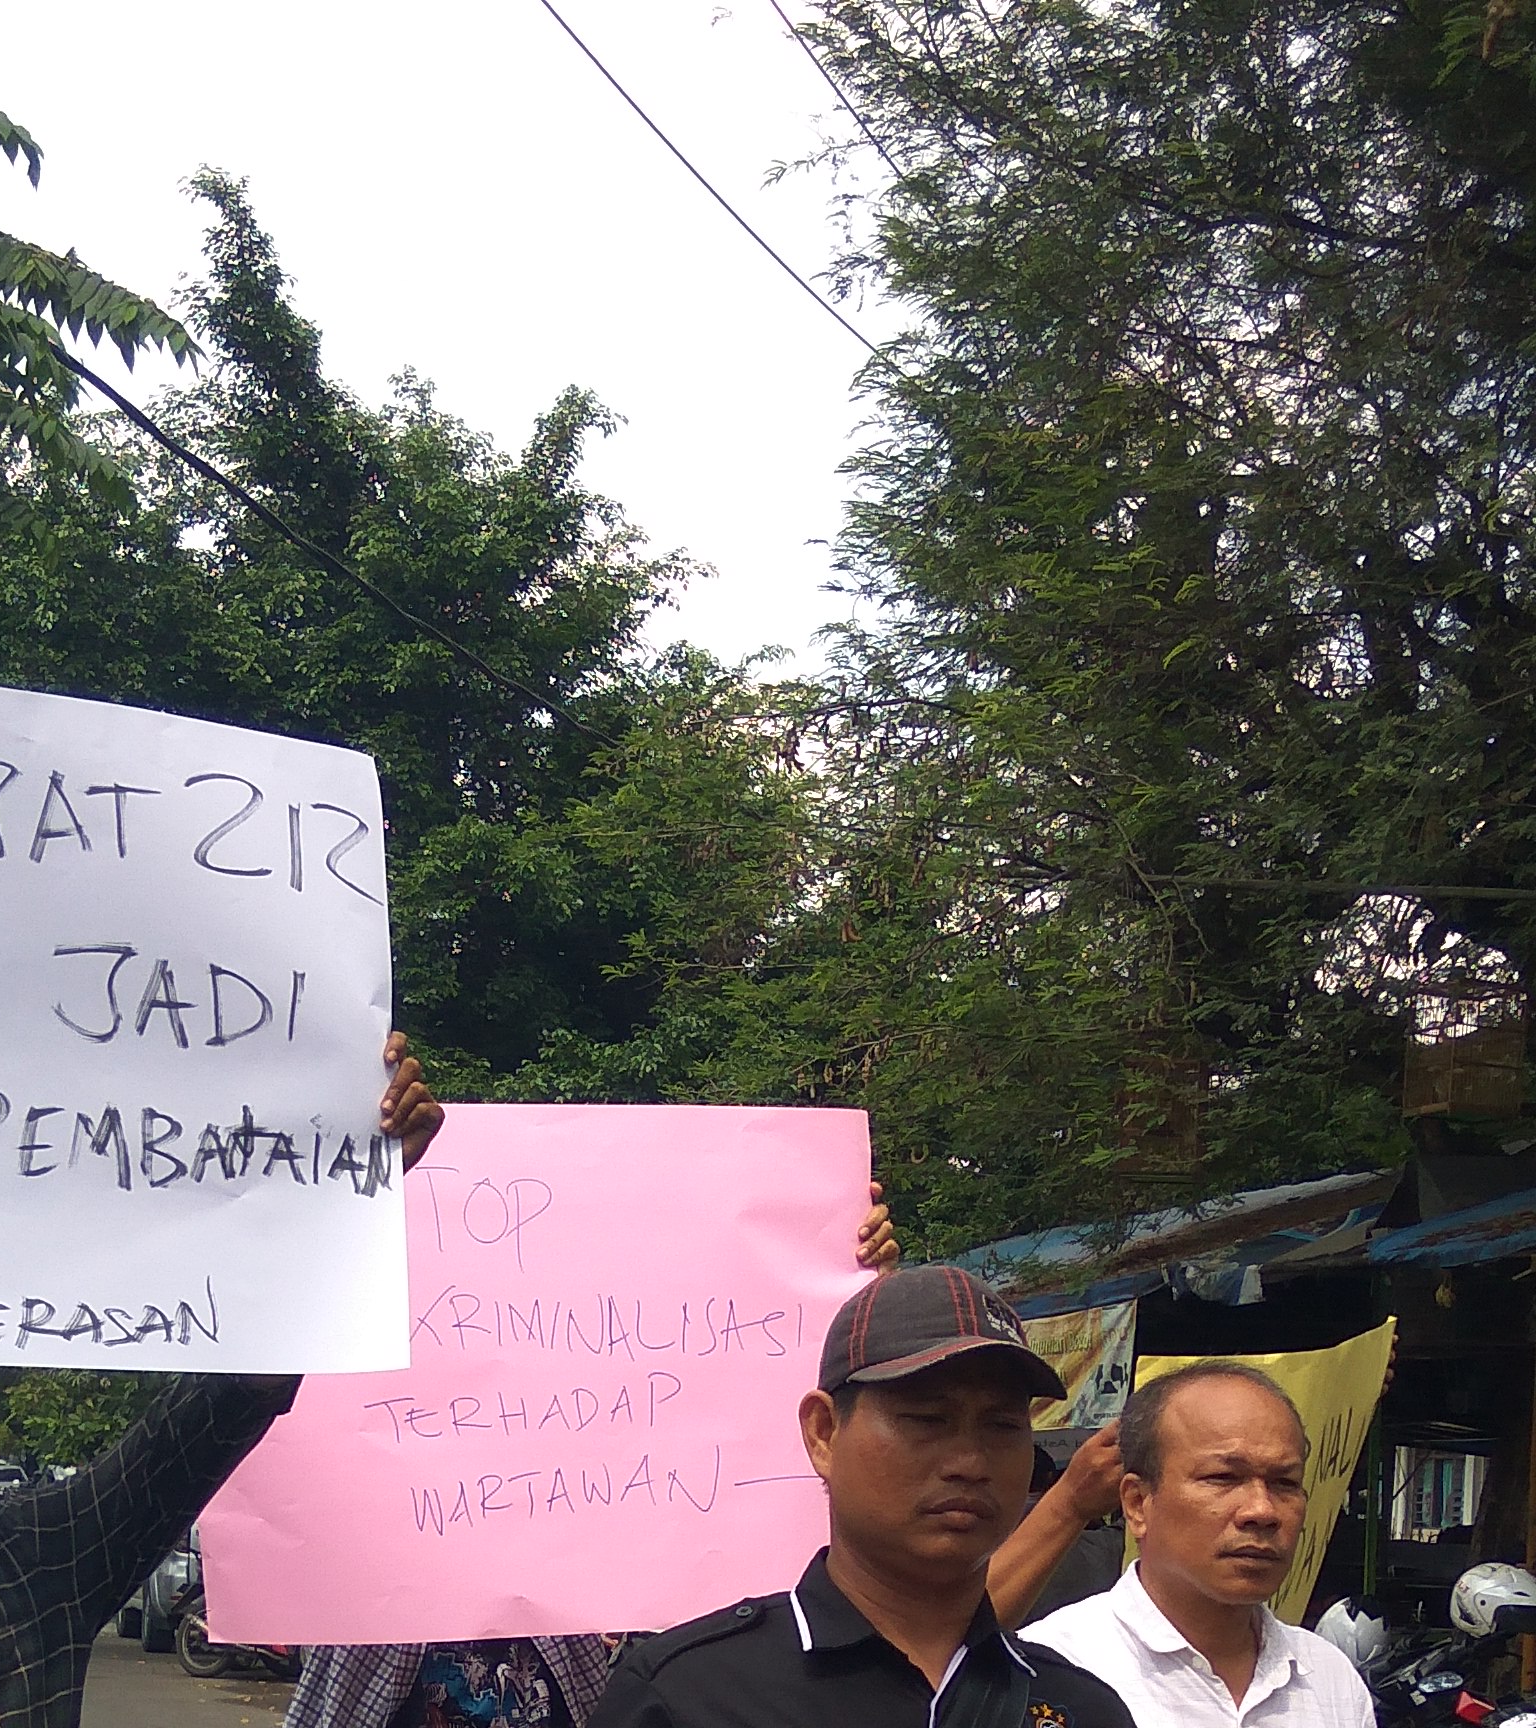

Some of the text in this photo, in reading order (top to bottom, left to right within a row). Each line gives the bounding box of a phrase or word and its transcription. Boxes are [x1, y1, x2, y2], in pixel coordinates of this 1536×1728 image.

[54, 943, 307, 1047] JADI
[364, 1372, 682, 1444] TERHADAP
[410, 1445, 721, 1537] WARTAWAN
